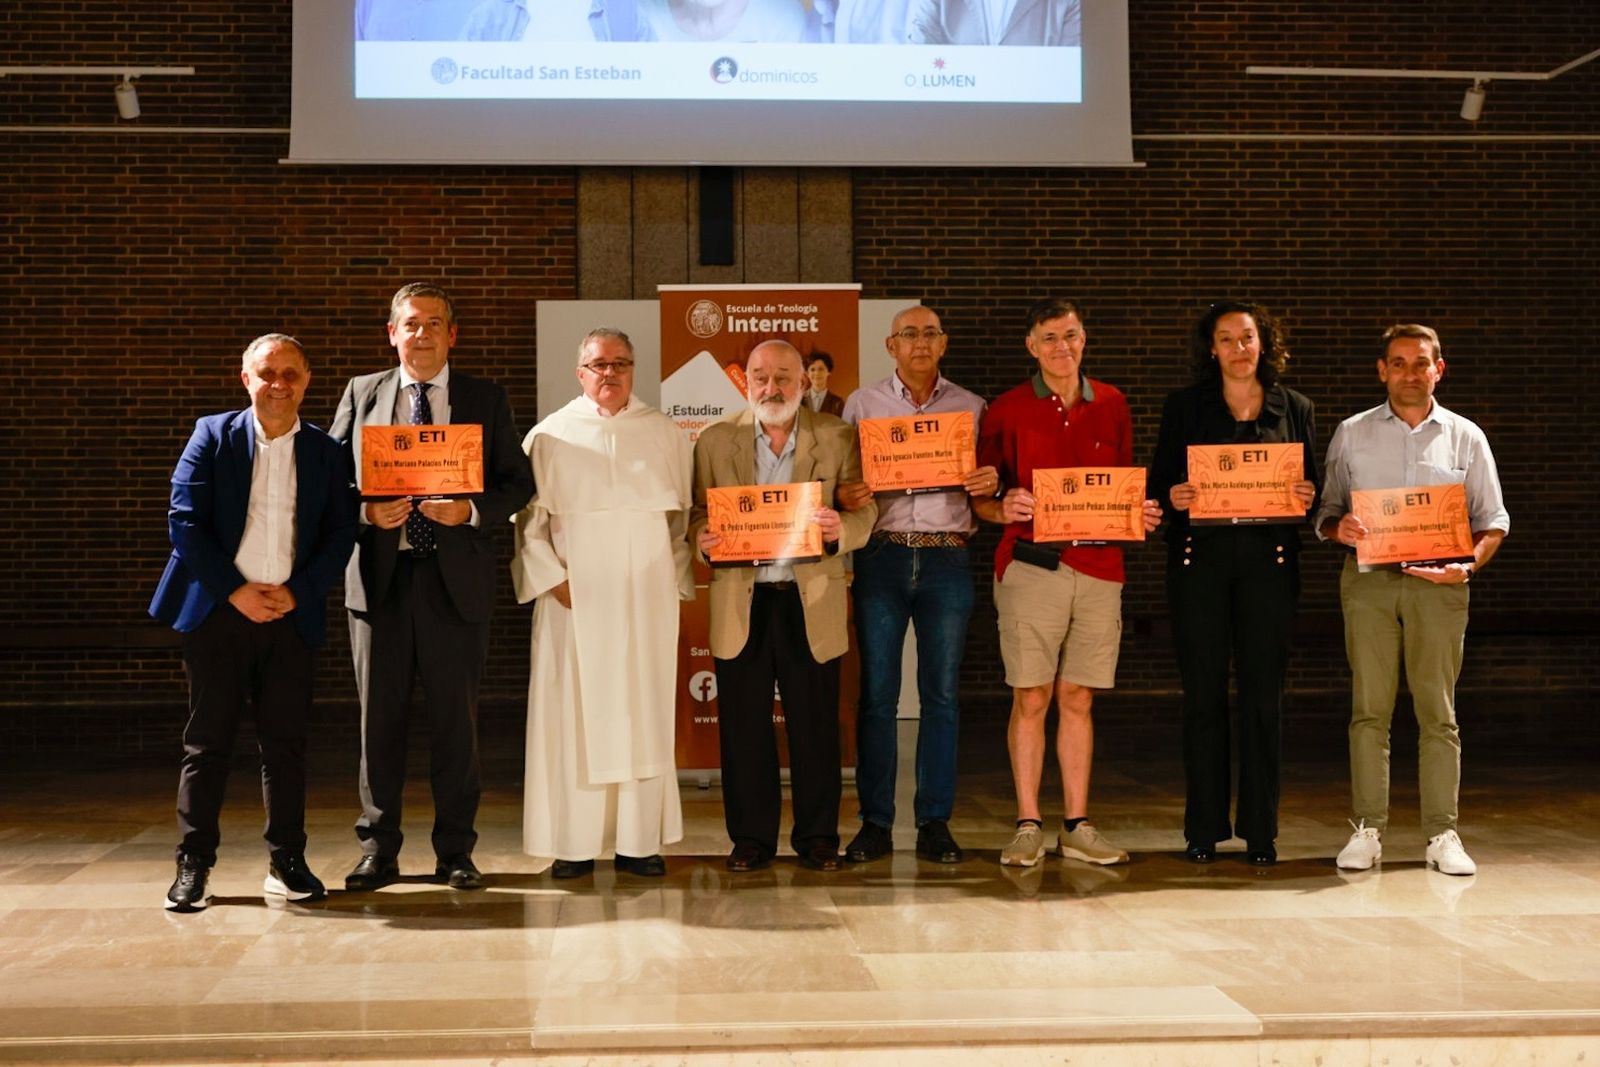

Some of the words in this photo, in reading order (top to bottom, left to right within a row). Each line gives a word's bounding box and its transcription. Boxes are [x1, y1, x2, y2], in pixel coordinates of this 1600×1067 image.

[460, 65, 534, 80] Facultad
[539, 66, 569, 80] San
[574, 66, 642, 80] Esteban
[739, 69, 818, 84] dominicos
[726, 303, 762, 313] Escuela
[763, 303, 776, 313] de
[777, 303, 818, 315] Teología
[727, 315, 819, 333] Internet
[666, 404, 724, 418] ¿Estudiar
[913, 420, 939, 434] ETI
[419, 430, 446, 443] ETI
[1243, 450, 1268, 462] ETI
[1085, 473, 1111, 486] ETI
[763, 490, 788, 503] ETI
[1405, 492, 1431, 506] ETI
[727, 523, 744, 531] Pedro
